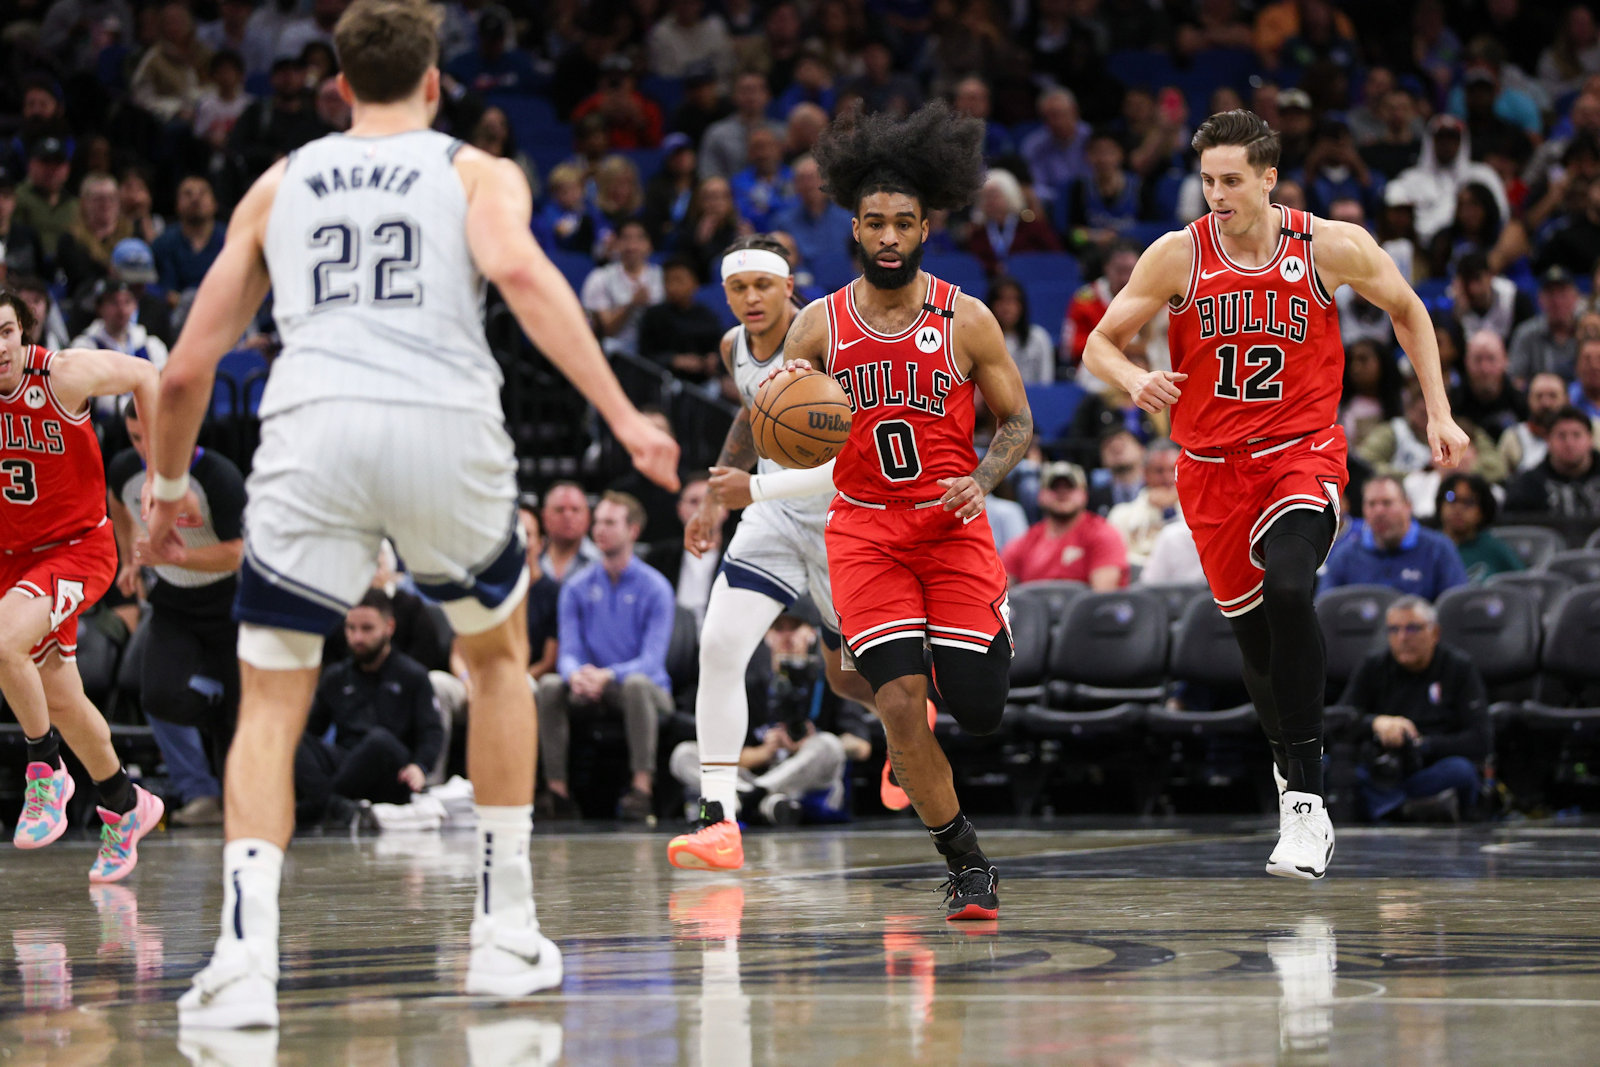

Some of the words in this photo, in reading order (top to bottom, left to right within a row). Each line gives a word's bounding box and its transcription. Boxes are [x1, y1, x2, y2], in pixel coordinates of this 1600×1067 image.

[304, 165, 421, 198] WAGNER
[307, 214, 423, 315] 22
[1195, 290, 1309, 344] BULLS
[1214, 343, 1285, 402] 12
[872, 418, 923, 483] 0
[0, 457, 39, 506] 3
